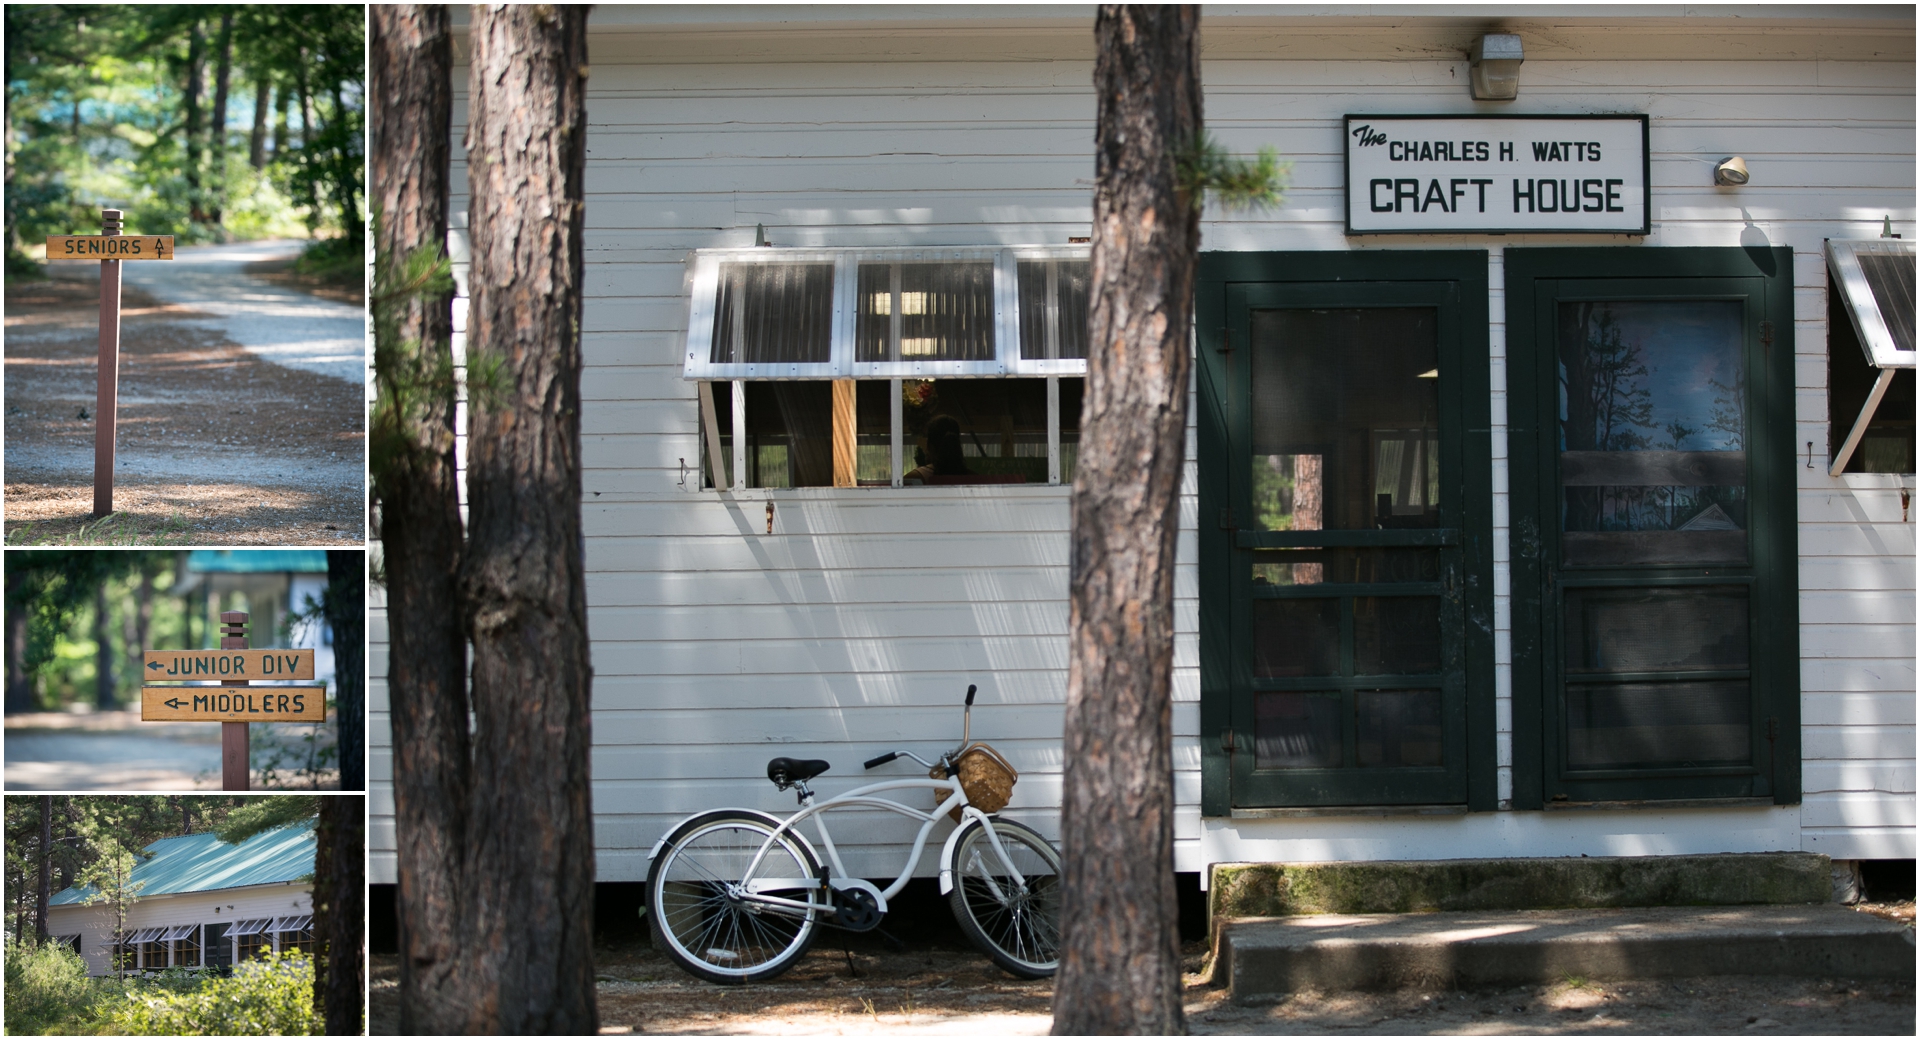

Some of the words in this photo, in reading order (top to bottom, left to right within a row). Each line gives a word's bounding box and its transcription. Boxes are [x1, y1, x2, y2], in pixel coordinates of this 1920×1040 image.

[1352, 125, 1387, 147] The
[1389, 141, 1490, 162] CHARLES
[1531, 141, 1601, 162] WATTS
[1369, 178, 1493, 213] CRAFT
[1512, 178, 1624, 213] HOUSE
[65, 239, 141, 254] SENIORS
[167, 655, 245, 675] JUNIOR
[262, 655, 299, 674] DIV
[193, 694, 305, 713] MIDDLERS
